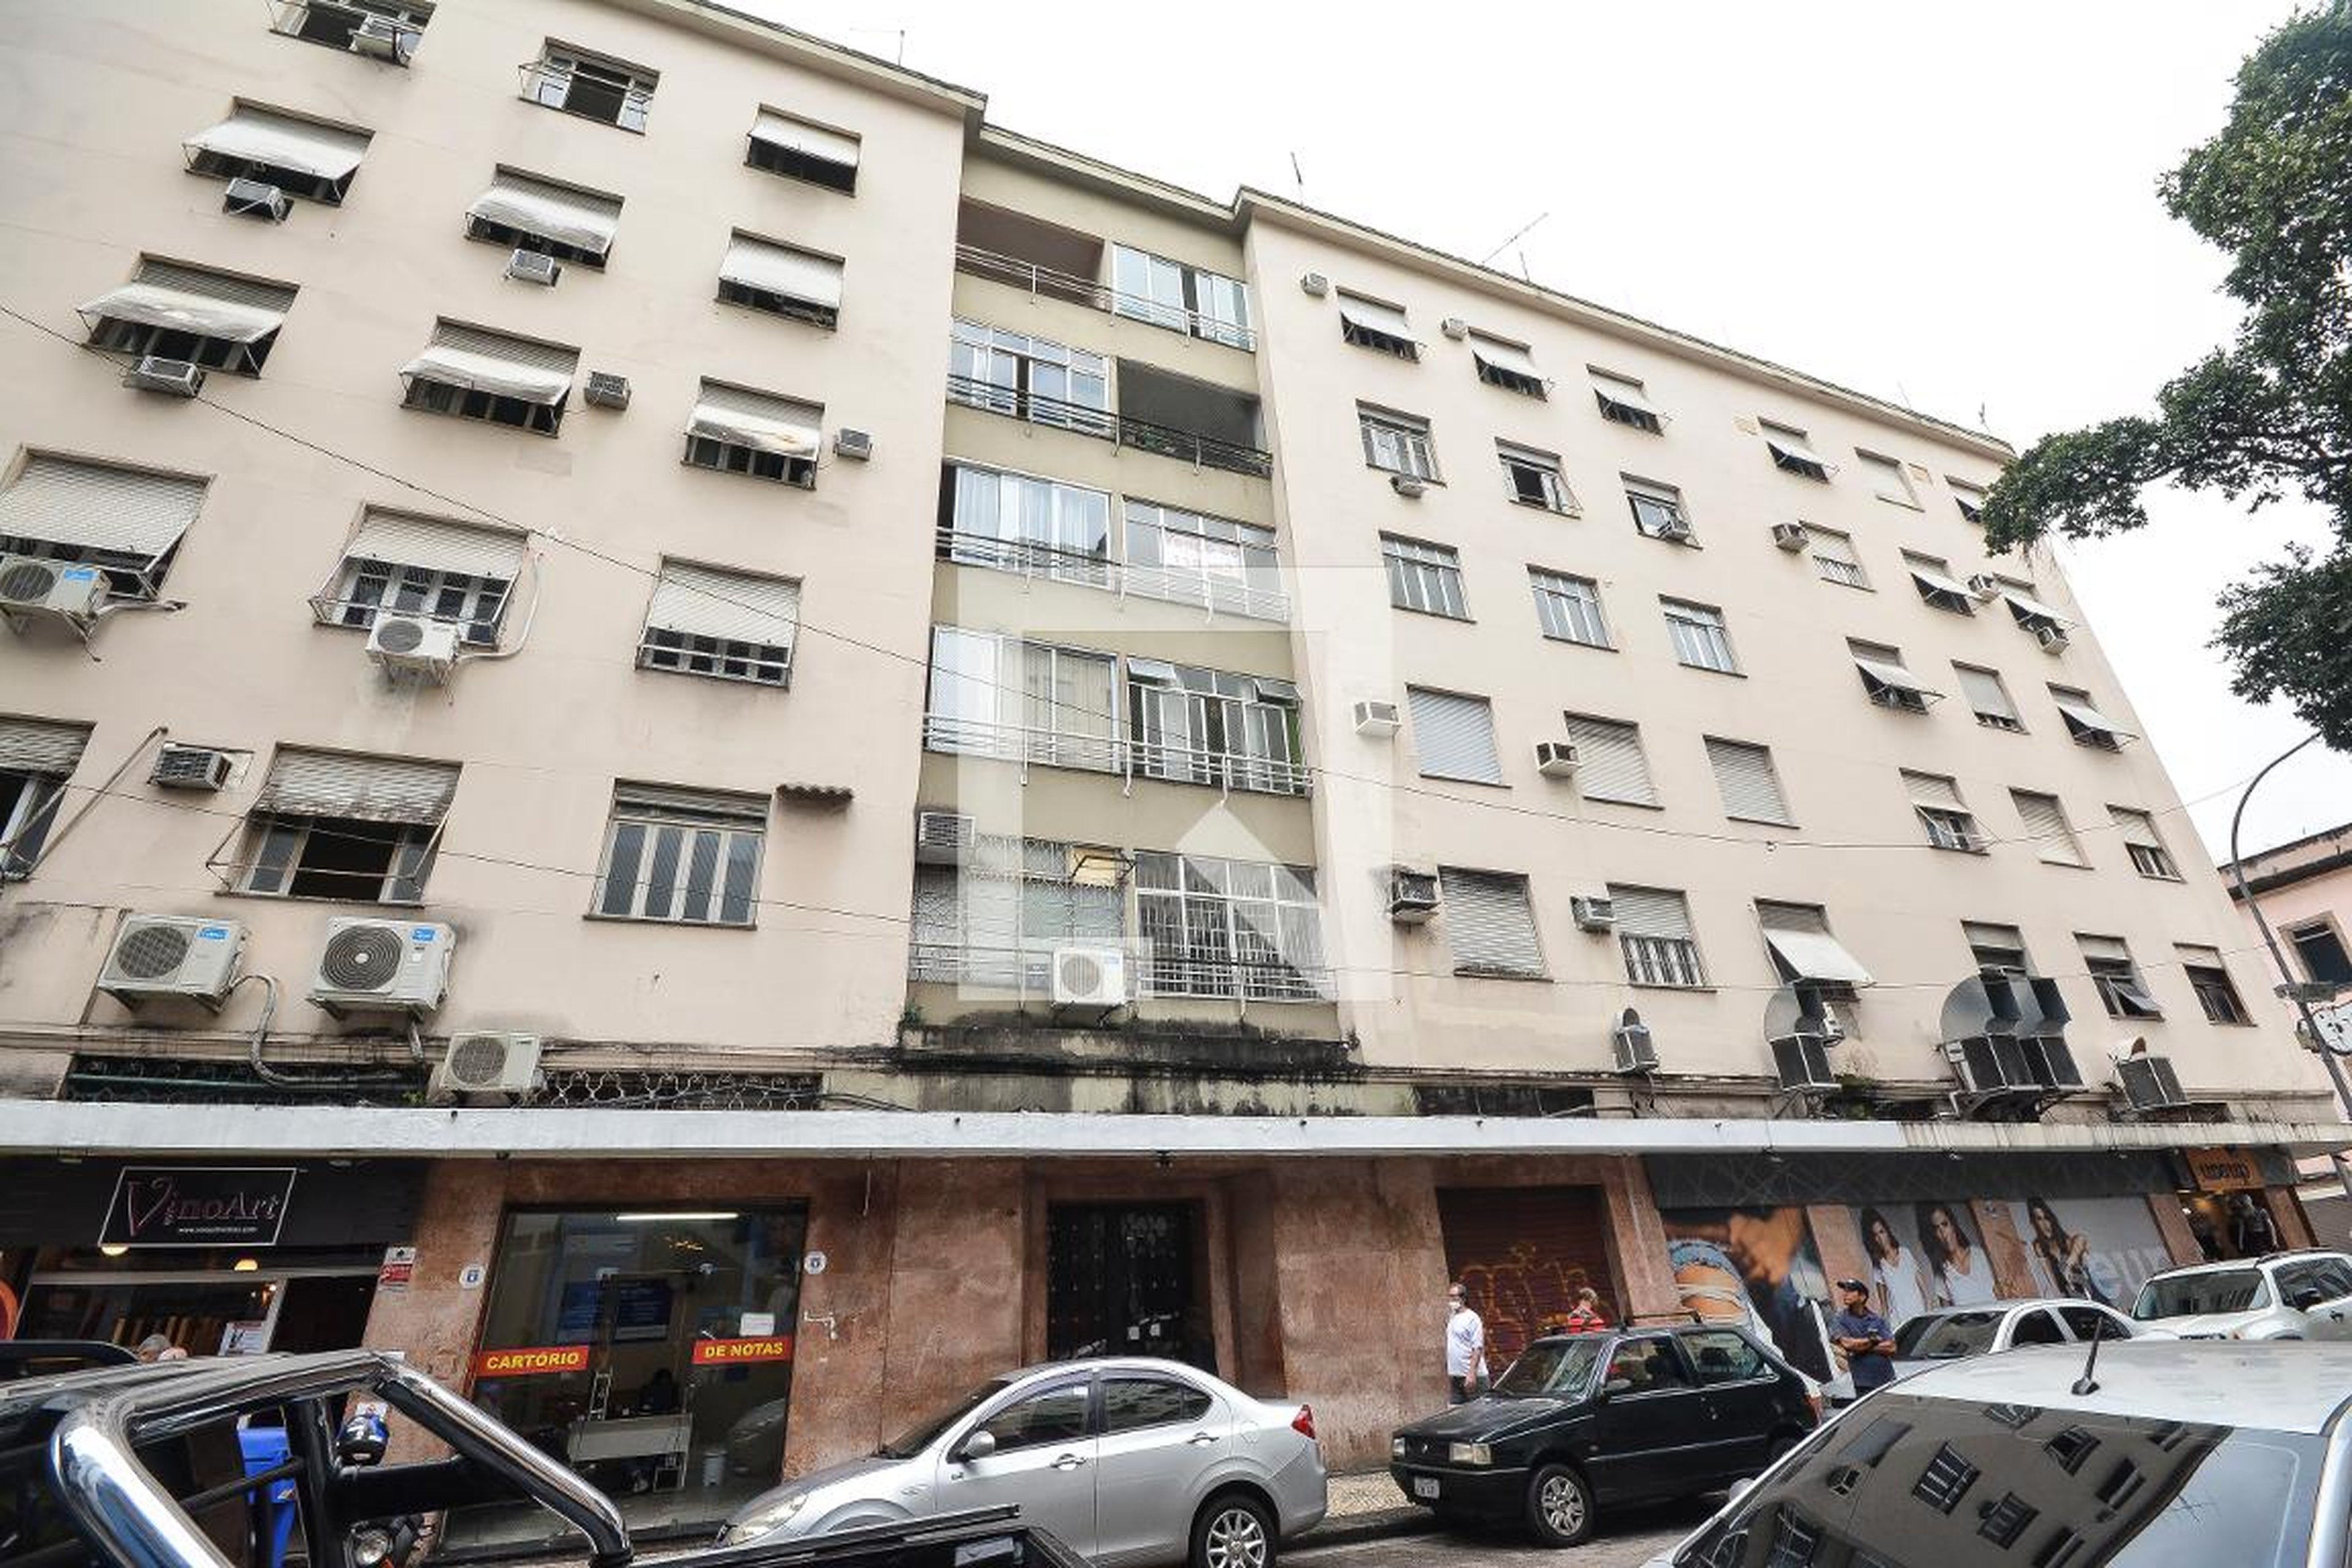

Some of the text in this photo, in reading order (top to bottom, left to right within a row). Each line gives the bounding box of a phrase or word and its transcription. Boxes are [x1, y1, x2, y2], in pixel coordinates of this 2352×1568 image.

[127, 1176, 279, 1236] VinoArt
[705, 1343, 783, 1357] DE NOTAS
[486, 1351, 579, 1370] CARTÓRIO
